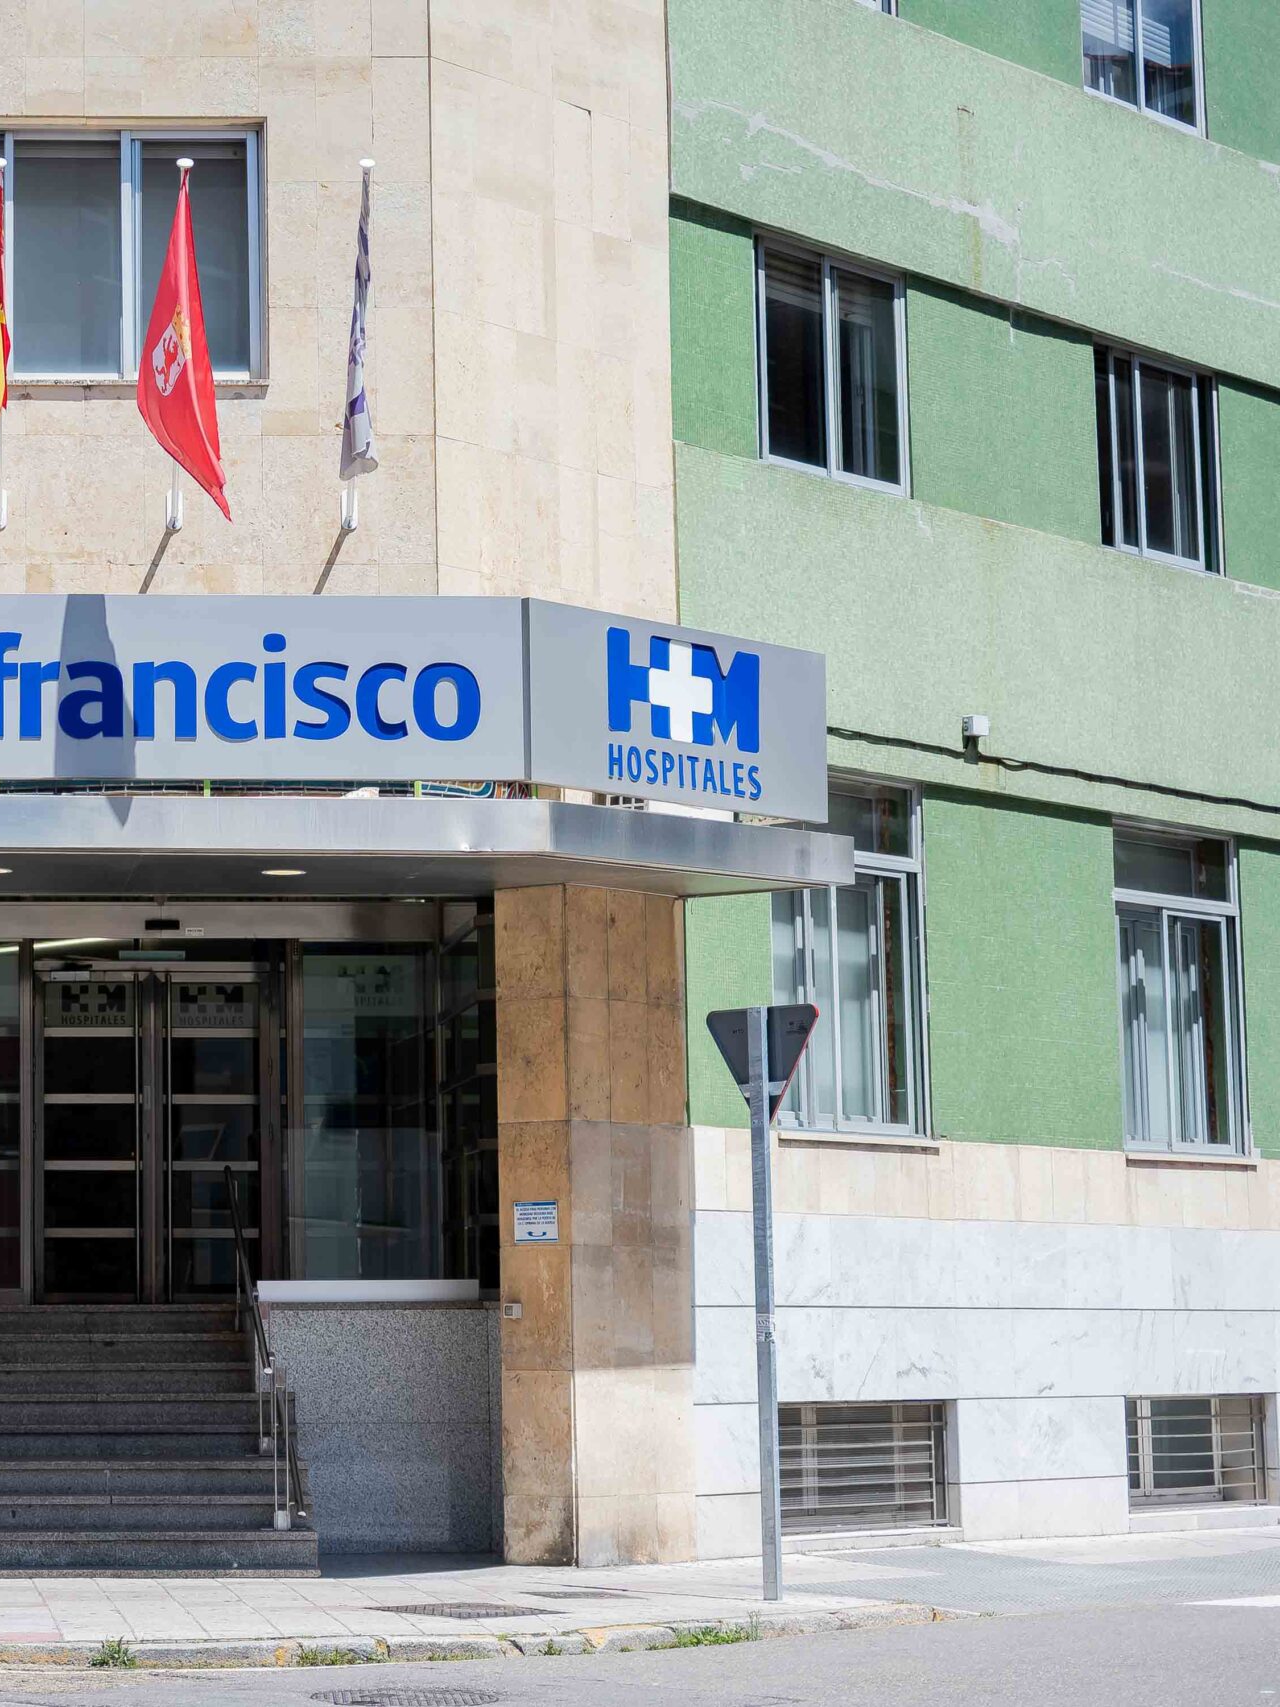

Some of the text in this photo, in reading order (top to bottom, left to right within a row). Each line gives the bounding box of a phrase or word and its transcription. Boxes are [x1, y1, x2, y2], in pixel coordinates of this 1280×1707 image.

[607, 743, 763, 801] HOSPITALES
[61, 1015, 126, 1025] HOSPITALES
[179, 1015, 244, 1026] HOSPITALES
